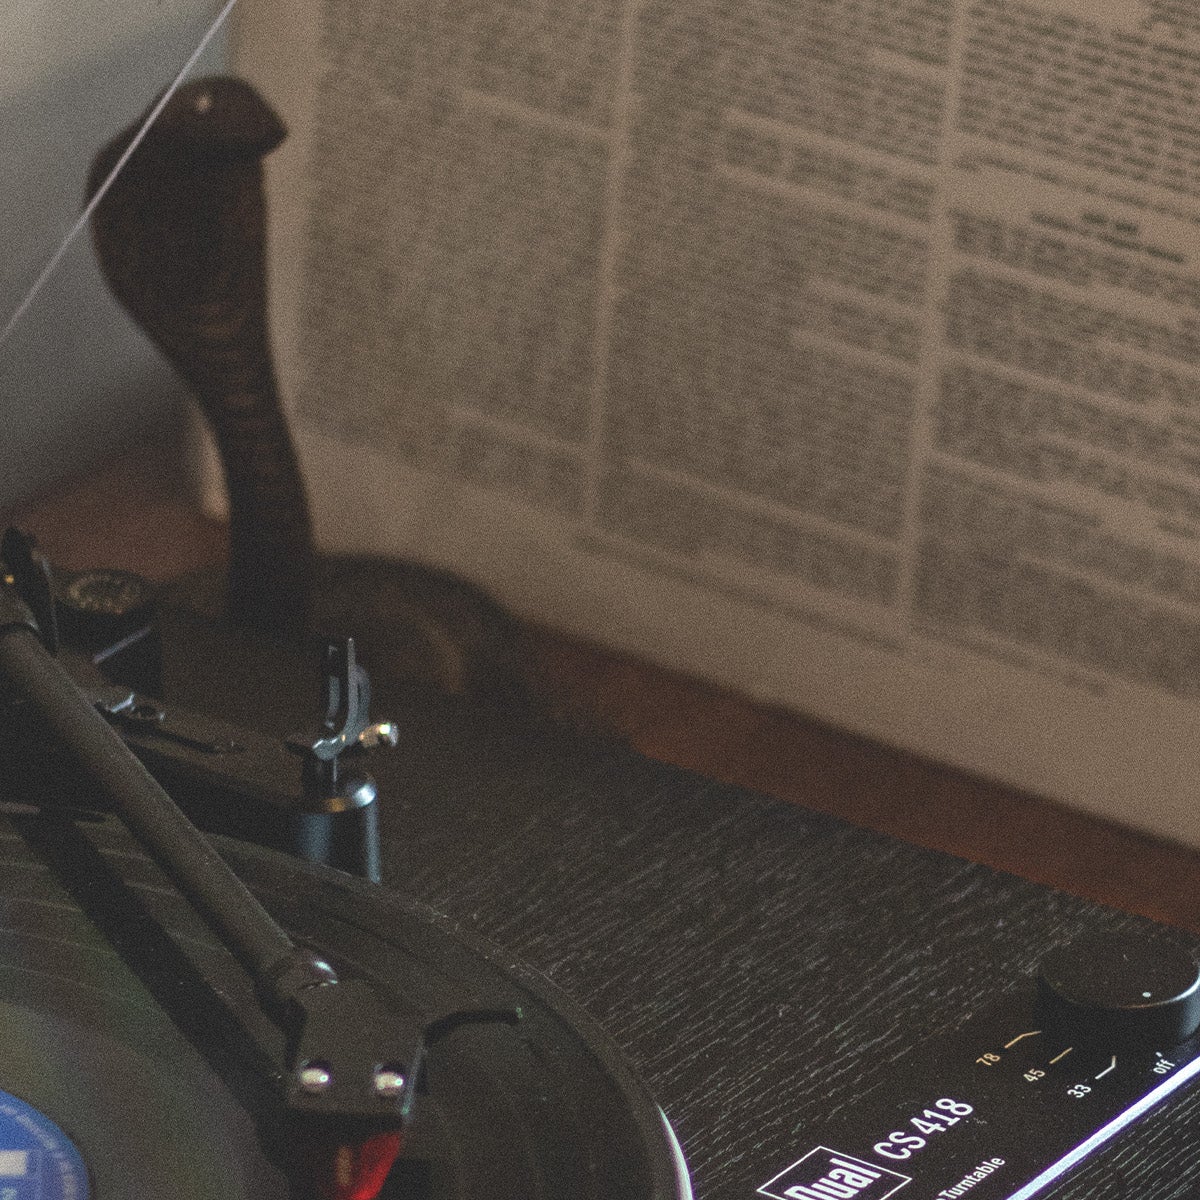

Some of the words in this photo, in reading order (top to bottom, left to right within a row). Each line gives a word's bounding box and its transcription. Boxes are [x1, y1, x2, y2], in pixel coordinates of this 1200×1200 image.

[976, 1053, 1001, 1066] 78
[1153, 1058, 1176, 1074] off
[1023, 1068, 1046, 1082] 45
[1067, 1084, 1092, 1098] 33
[873, 1131, 927, 1160] CS
[910, 1098, 974, 1135] 418
[938, 1157, 1006, 1199] Turntable
